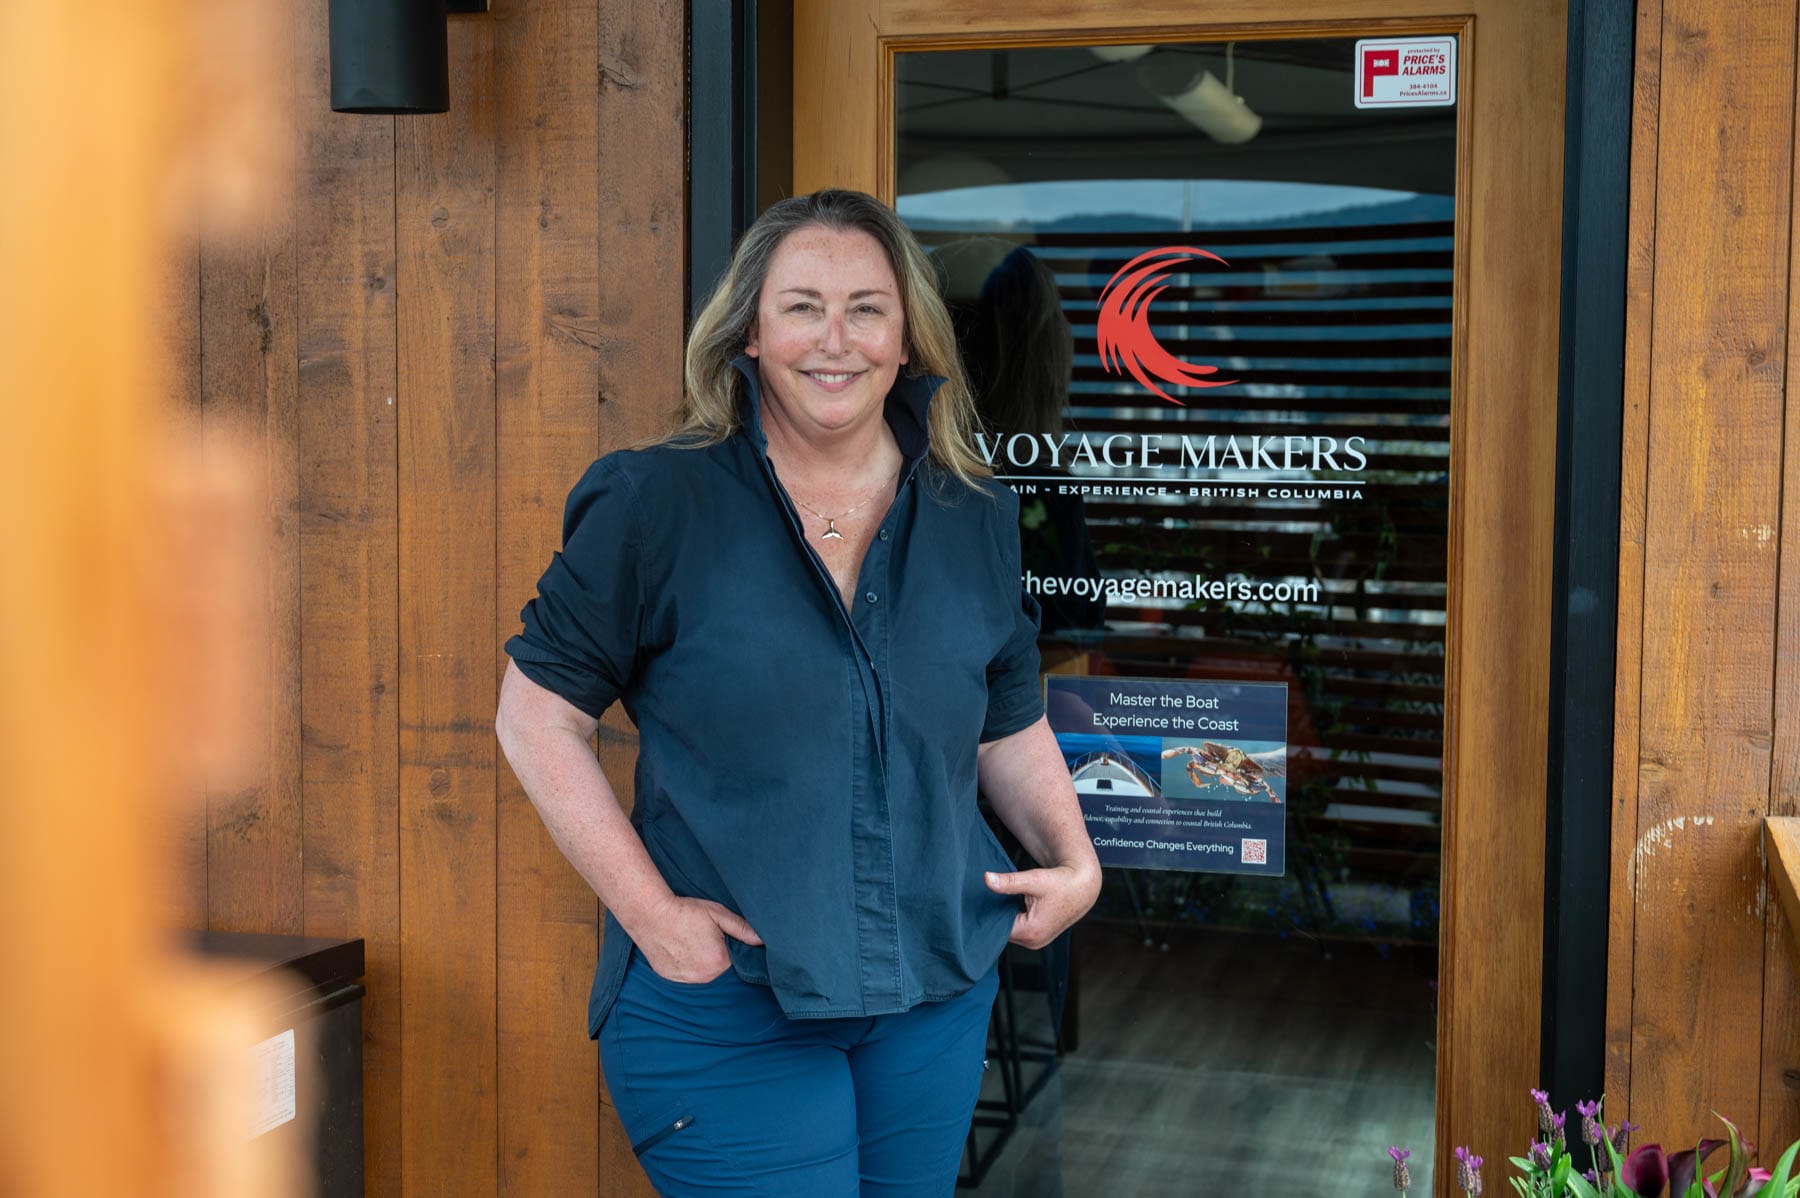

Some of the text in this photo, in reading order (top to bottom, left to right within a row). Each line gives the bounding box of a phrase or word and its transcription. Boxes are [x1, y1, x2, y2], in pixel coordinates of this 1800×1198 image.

[1403, 54, 1445, 64] PRICE'S
[1402, 65, 1446, 76] ALARMS
[974, 432, 1367, 472] VOYAGE MAKERS
[1010, 485, 1037, 494] AIN
[1059, 485, 1167, 497] EXPERIENCE
[1189, 487, 1259, 498] BRITISH
[1268, 488, 1363, 500] COLUMBIA
[1110, 692, 1220, 709] Master the Boat
[1093, 712, 1240, 732] Experience the Coast
[1105, 804, 1130, 814] Training
[1162, 808, 1193, 817] experiences
[1193, 808, 1204, 816] that
[1206, 809, 1223, 817] build
[1105, 815, 1132, 825] capability
[1133, 816, 1145, 824] and
[1145, 817, 1175, 825] connection
[1183, 819, 1203, 827] coastal
[1203, 820, 1222, 828] British
[1224, 821, 1252, 829] Columbia.
[1093, 837, 1234, 855] Confidence Changes Everything
